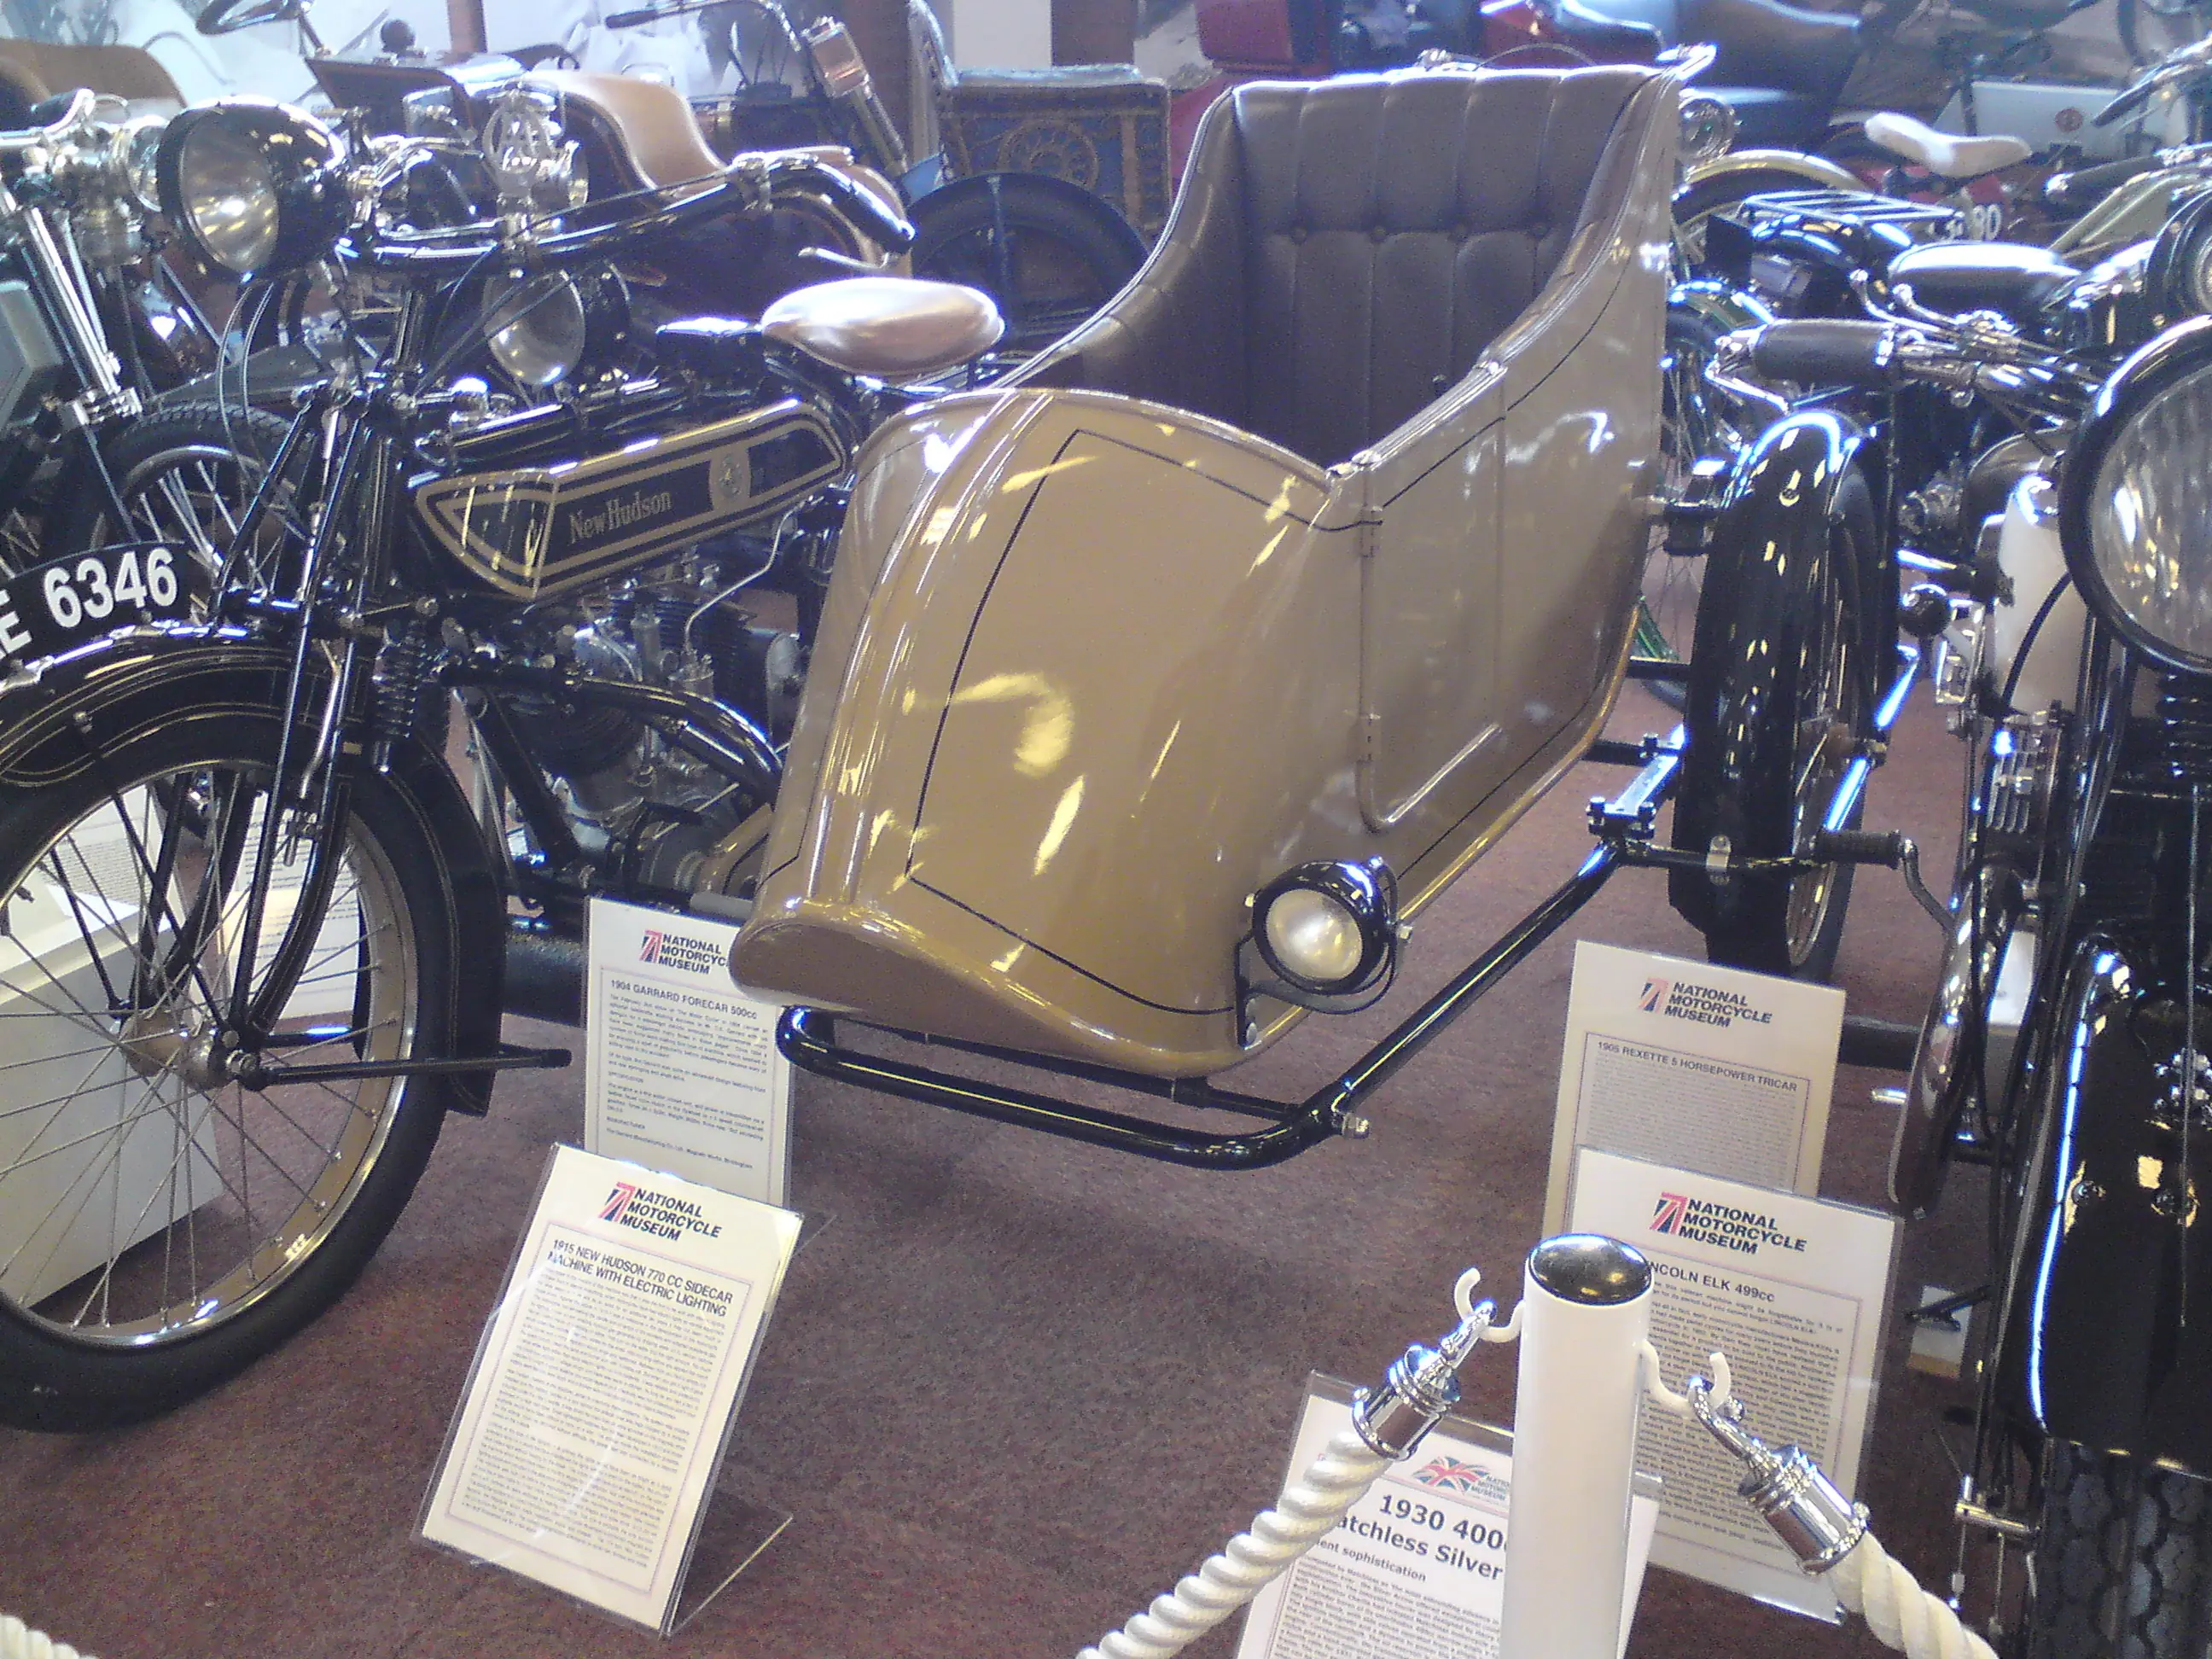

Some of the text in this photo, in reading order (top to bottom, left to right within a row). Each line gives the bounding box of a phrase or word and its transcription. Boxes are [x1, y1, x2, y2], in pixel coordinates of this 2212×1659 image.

[44, 547, 178, 628] 6346
[661, 945, 729, 968] MOTORCYC
[663, 934, 721, 954] NATIONAL
[659, 956, 710, 975] MUSEUM
[611, 980, 758, 1020] 1904 GARRARD FORECAR 500cc
[1668, 993, 1773, 1023] MOTORCYCLE
[1674, 982, 1749, 1006] NATIONAL
[1665, 1004, 1732, 1027] MUSEUM
[1598, 1042, 1798, 1091] 1905 REXETTE 5 HORSEPOWER TRICAR
[627, 1202, 722, 1237] MOTORCYCLE
[634, 1188, 702, 1218] NATIONAL
[1687, 1199, 1778, 1230] NATIONAL
[620, 1214, 682, 1241] MUSEUM
[1679, 1225, 1758, 1254] MUSEUM
[1683, 1212, 1807, 1252] MOTORCYCLE
[553, 1239, 733, 1304] 1915 NEW HUDSON 770 CC SIDECAR
[1648, 1261, 1775, 1302] NCOLN ELK 499cc
[597, 1266, 622, 1284] WITH
[623, 1274, 675, 1300] ELECTRIC
[676, 1290, 727, 1317] LIGHTING
[1379, 1494, 1507, 1551] 1930 400
[1337, 1516, 1504, 1580] atchless Silver
[1342, 1547, 1427, 1582] sophistication
